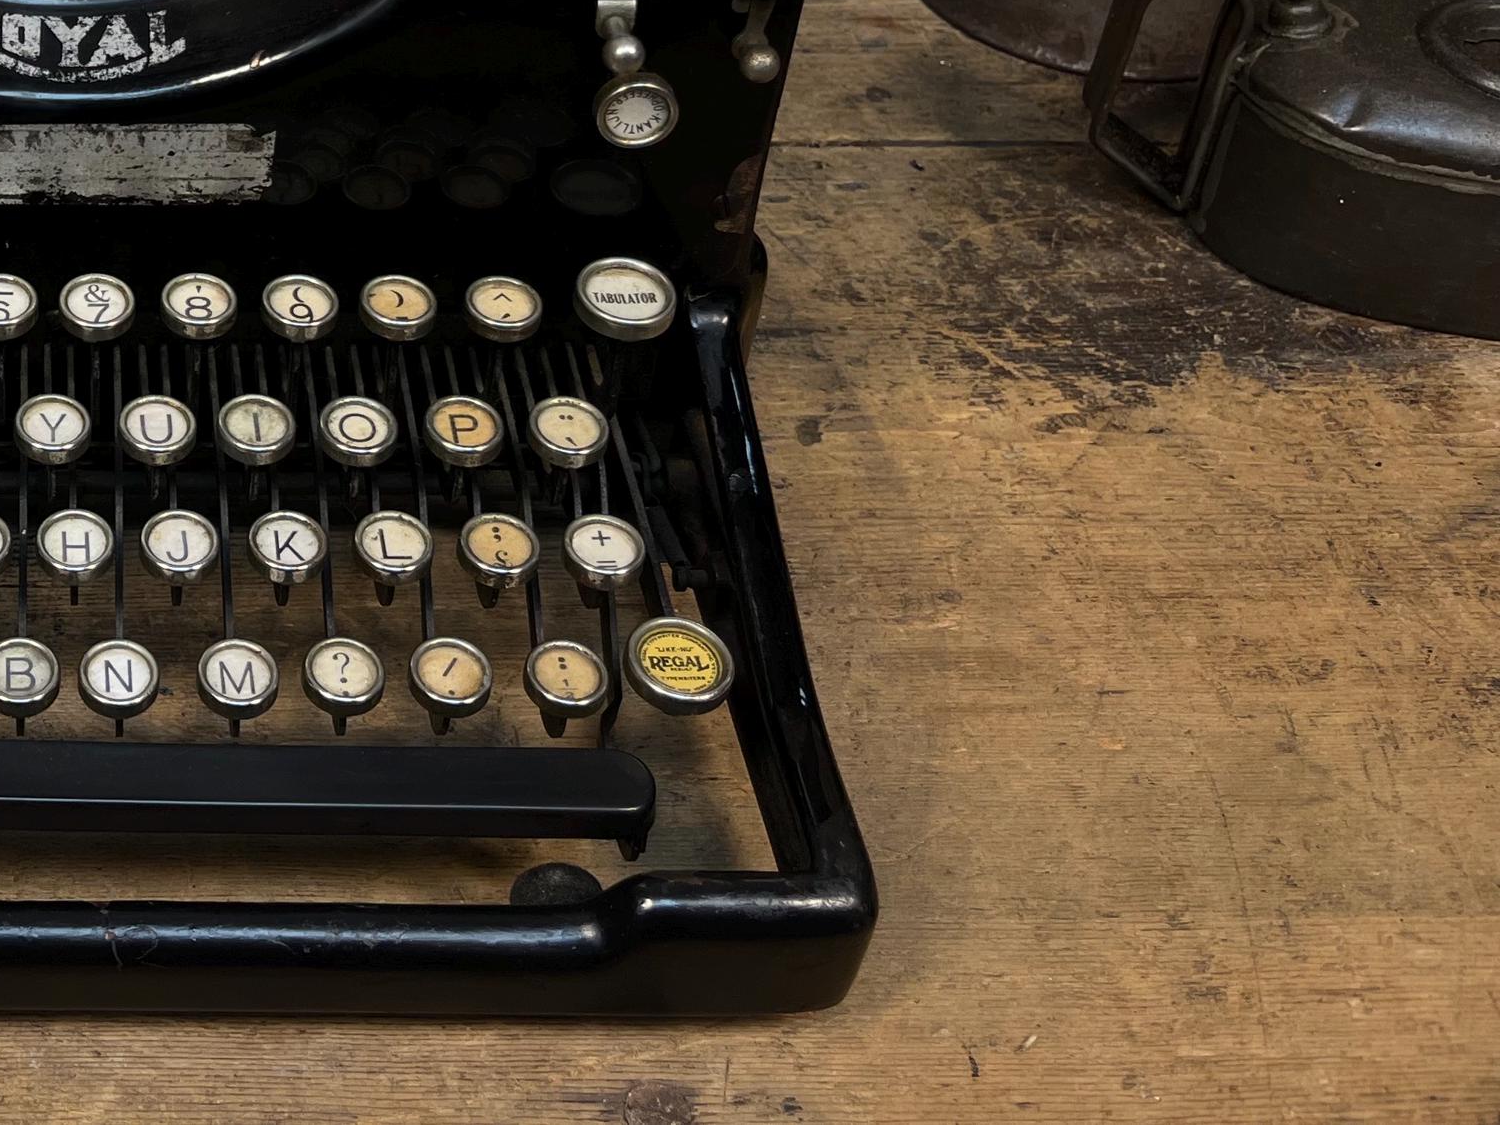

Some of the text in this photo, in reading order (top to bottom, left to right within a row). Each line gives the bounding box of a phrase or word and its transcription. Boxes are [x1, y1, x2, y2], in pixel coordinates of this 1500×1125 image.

[87, 304, 110, 323] 7
[184, 296, 212, 321] 8
[289, 303, 314, 323] 9
[592, 291, 659, 306] TABULATOR
[40, 413, 67, 443] Y
[140, 413, 173, 444] U
[338, 413, 377, 443] O
[448, 414, 479, 444] P
[61, 531, 90, 562] H
[166, 530, 187, 563] J
[273, 530, 305, 561] K
[377, 528, 413, 560] L
[5, 657, 36, 692] B
[104, 659, 133, 693] N
[219, 660, 256, 695] M
[648, 655, 710, 672] REGAL
